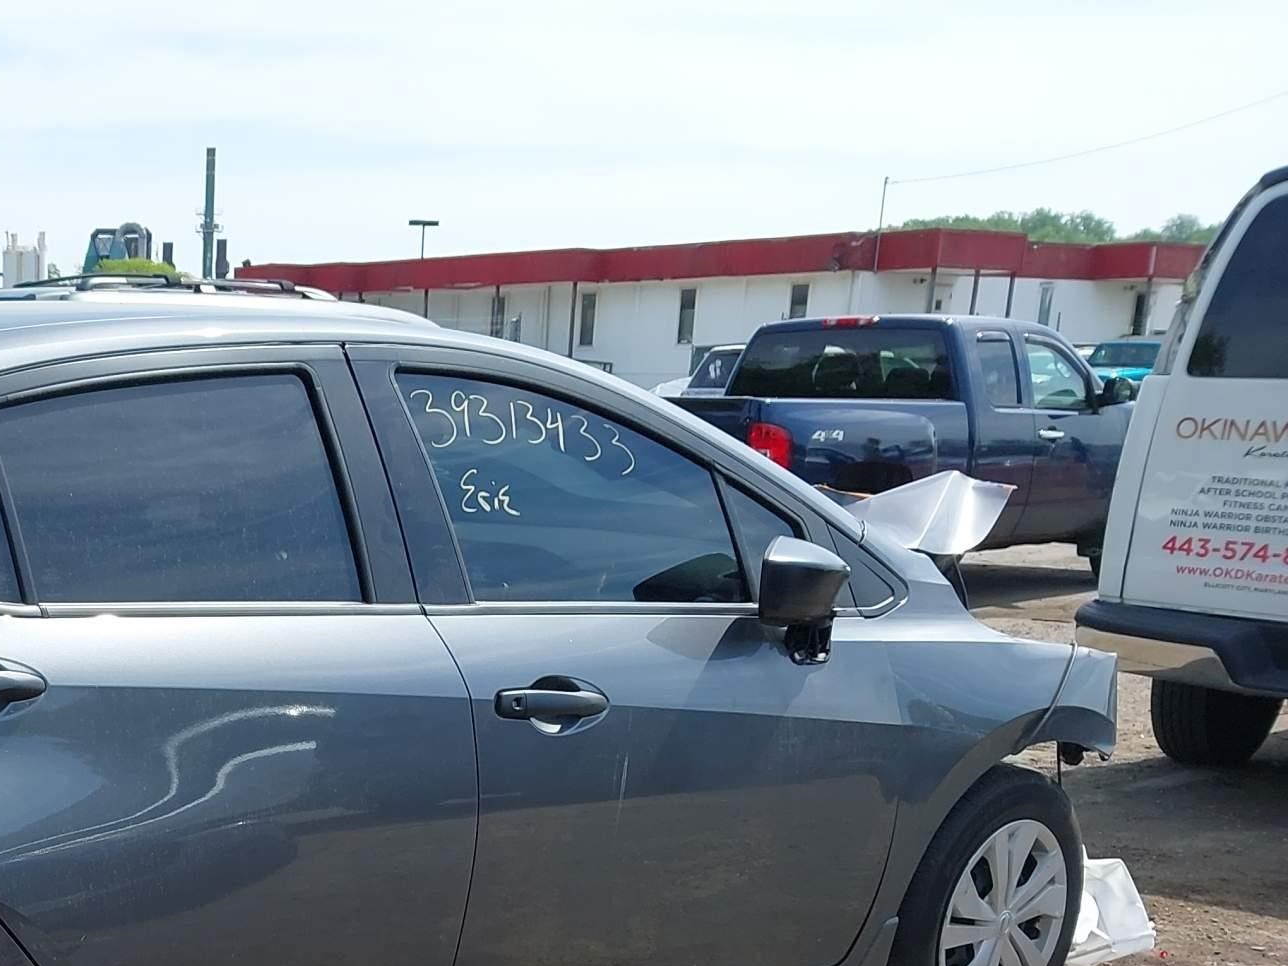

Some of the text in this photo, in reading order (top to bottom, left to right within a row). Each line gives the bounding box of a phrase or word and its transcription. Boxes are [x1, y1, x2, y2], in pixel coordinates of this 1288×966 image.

[410, 389, 636, 476] 39313433
[1211, 475, 1281, 489] TRADITIONAL
[1198, 487, 1233, 497] AFTER
[1235, 489, 1278, 500] SCHOOL
[1223, 500, 1265, 511] FITNESS
[1170, 508, 1200, 517] NINJA
[1203, 510, 1253, 521] WARRIOR
[1169, 519, 1199, 529] NINJA
[1202, 522, 1251, 532] WARRIOR
